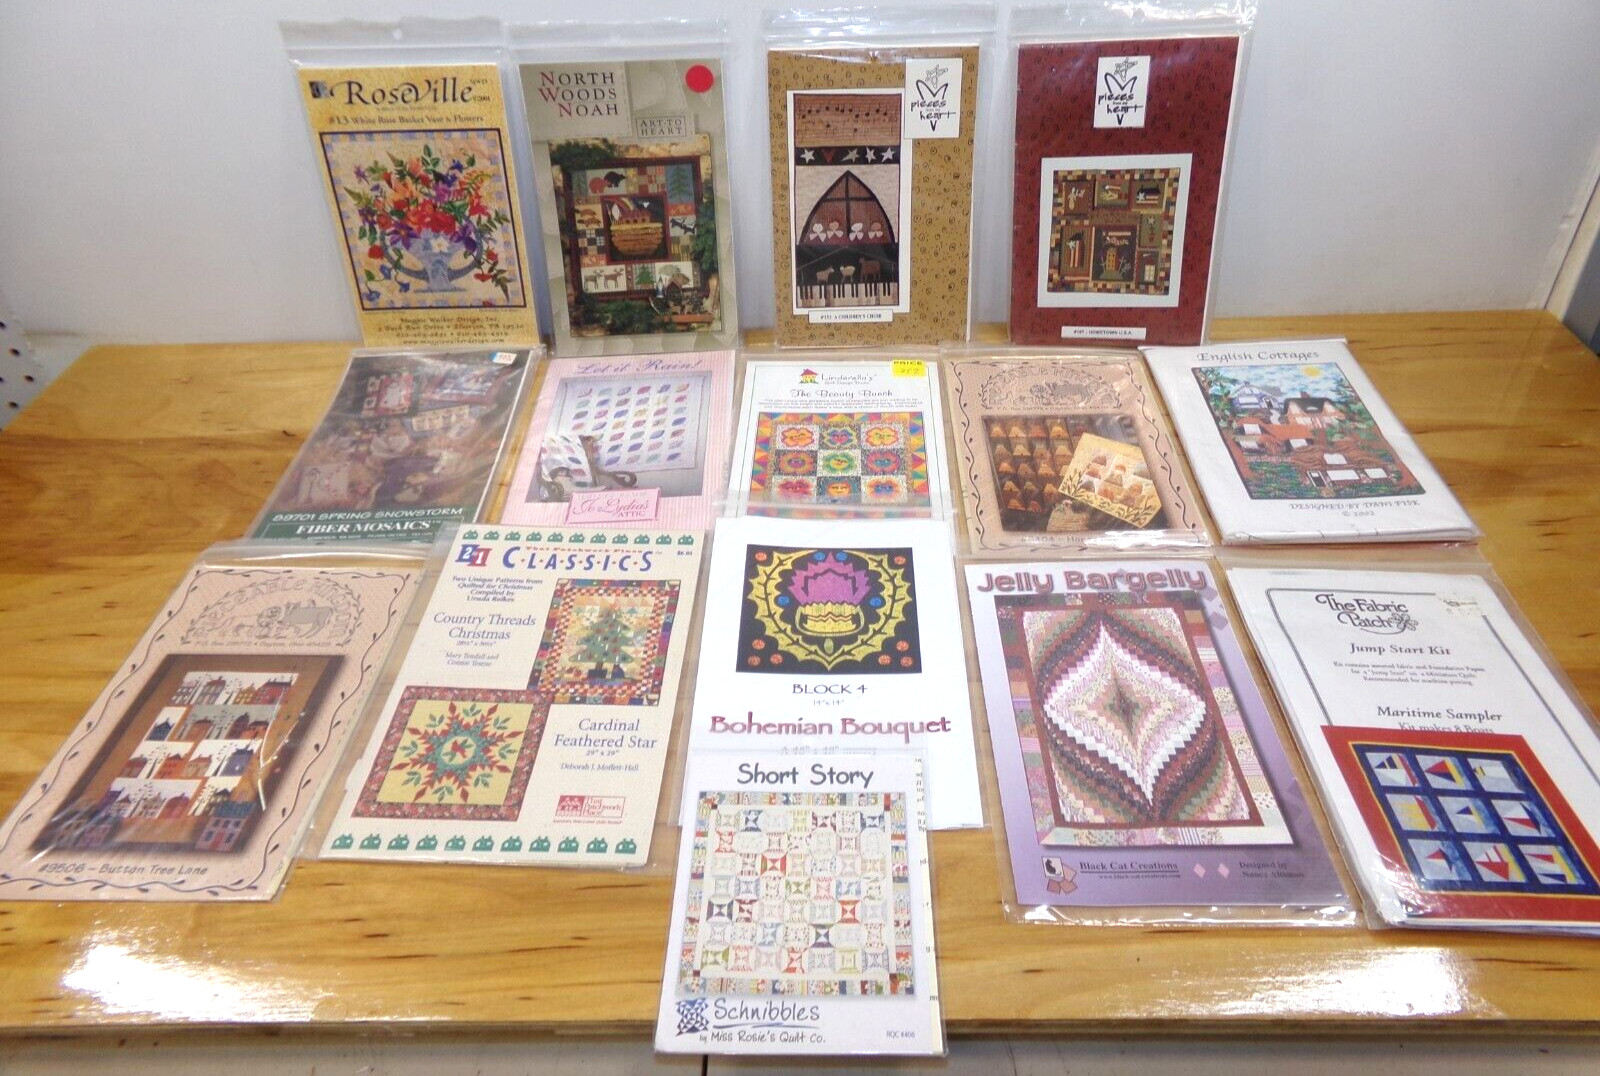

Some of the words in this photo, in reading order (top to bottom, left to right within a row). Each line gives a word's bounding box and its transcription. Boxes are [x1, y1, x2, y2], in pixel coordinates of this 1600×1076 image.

[540, 71, 615, 86] NORTH
[538, 87, 617, 102] WOODS
[1098, 93, 1134, 105] pieces
[558, 103, 619, 117] NOAH
[911, 100, 947, 112] pieces
[1107, 104, 1144, 114] heart
[351, 116, 375, 125] White
[378, 115, 396, 124] Rose
[399, 115, 424, 124] Basket
[453, 114, 484, 123] Flowers
[920, 110, 956, 121] heart
[640, 126, 683, 136] HEART
[1196, 352, 1252, 363] English
[1257, 350, 1320, 361] Cottages
[790, 388, 811, 397] The
[815, 389, 854, 399] Beauty
[859, 389, 893, 398] Bunch
[318, 511, 371, 521] SPRING
[374, 507, 464, 519] SNOWSTORM
[1289, 503, 1344, 511] DESIGNED
[295, 524, 350, 534] FIBER
[352, 520, 431, 533] MOSAICS
[977, 571, 1054, 594] Jelly
[1064, 568, 1208, 592] Bargelly
[470, 589, 504, 597] Compiled
[1315, 593, 1357, 611] The
[1353, 598, 1408, 612] Fabric
[433, 611, 485, 630] Country
[489, 613, 537, 626] Threads
[1337, 611, 1393, 627] Patch
[448, 626, 511, 640] Christmas
[1349, 642, 1385, 656] Jump
[1389, 644, 1424, 655] Start
[1427, 645, 1452, 655] Kit
[792, 683, 852, 694] BLOCK
[856, 684, 868, 694] 4
[1377, 705, 1442, 719] Maritime
[1446, 708, 1503, 722] Sampler
[578, 718, 641, 732] Cardinal
[709, 711, 833, 735] Bohemian
[840, 716, 951, 744] Bouquet
[554, 733, 624, 748] Feathered
[628, 735, 657, 748] Star
[560, 762, 590, 771] Deborah
[737, 762, 799, 785] Short
[810, 763, 874, 788] Story
[99, 864, 145, 874] Button
[149, 864, 174, 874] Tree
[178, 864, 208, 875] Lane
[1080, 862, 1107, 870] Black
[1110, 861, 1128, 870] Cat
[1130, 862, 1178, 870] Creations
[1239, 861, 1276, 870] Designed
[1277, 860, 1288, 870] by
[713, 998, 820, 1021] Schnibbles
[711, 1031, 733, 1042] Miss
[738, 1030, 775, 1042] Rosie's
[779, 1030, 805, 1043] Quilt
[809, 1032, 826, 1043] Co.
